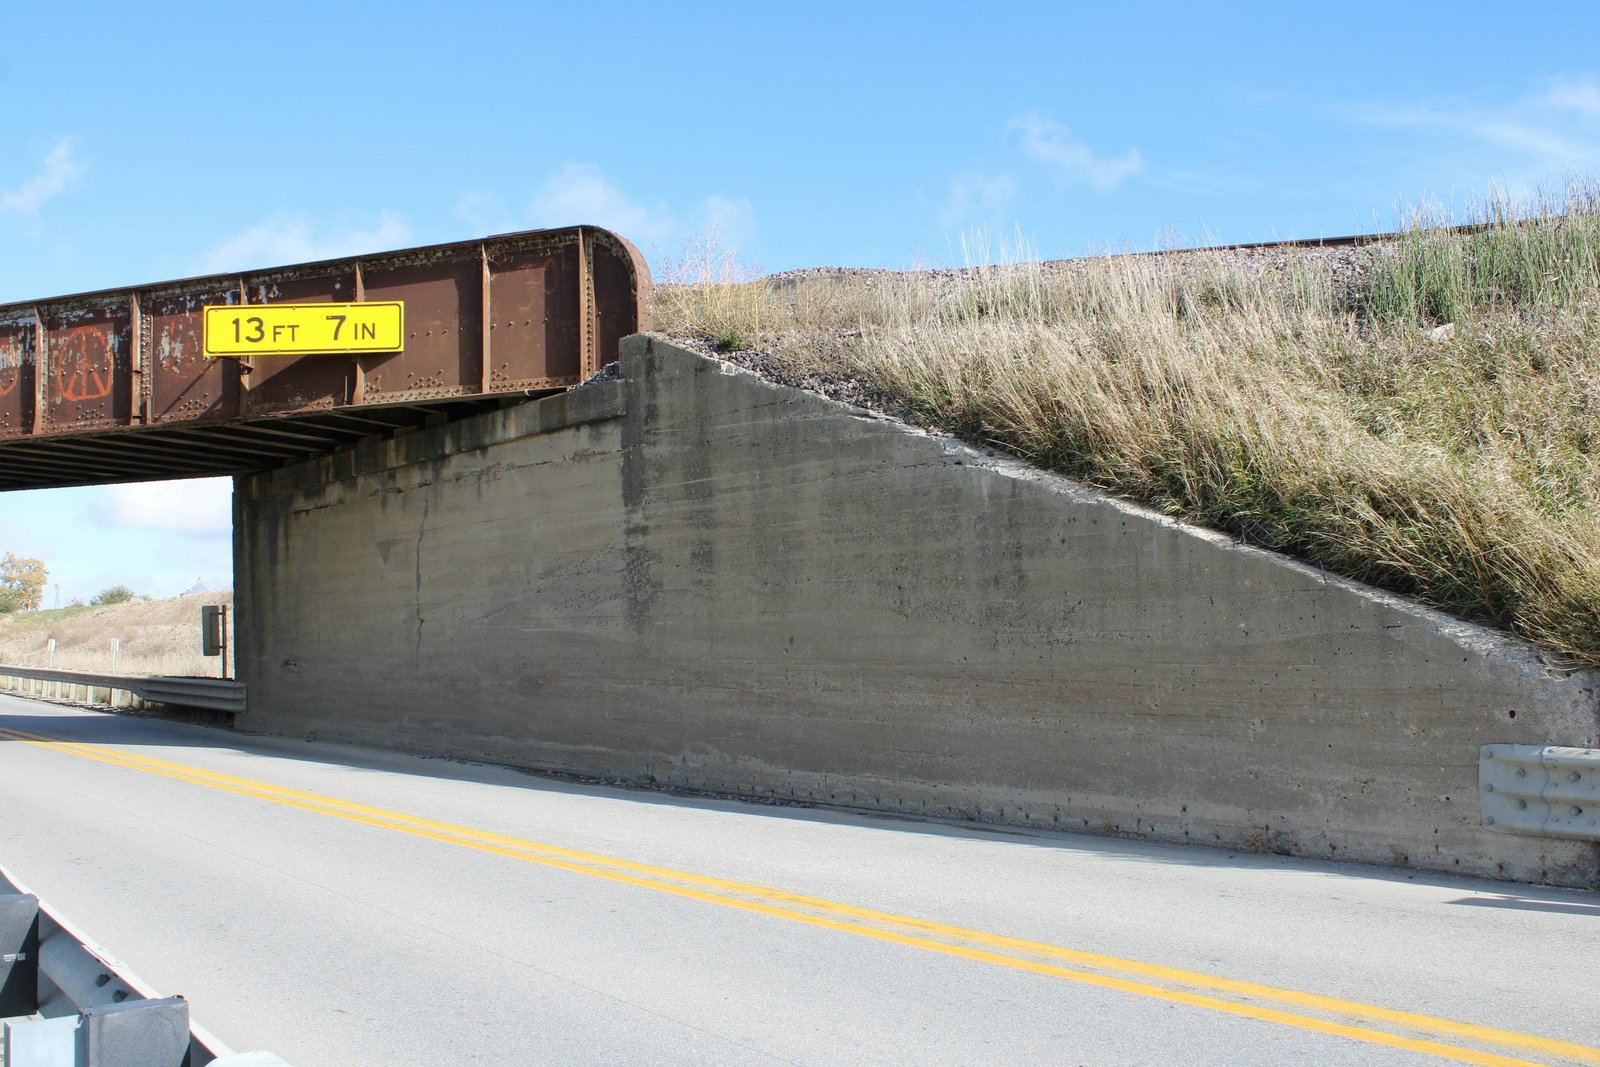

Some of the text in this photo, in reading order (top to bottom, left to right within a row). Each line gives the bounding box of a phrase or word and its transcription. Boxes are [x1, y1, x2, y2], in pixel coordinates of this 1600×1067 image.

[232, 315, 376, 343] 13 FT 7 IN
